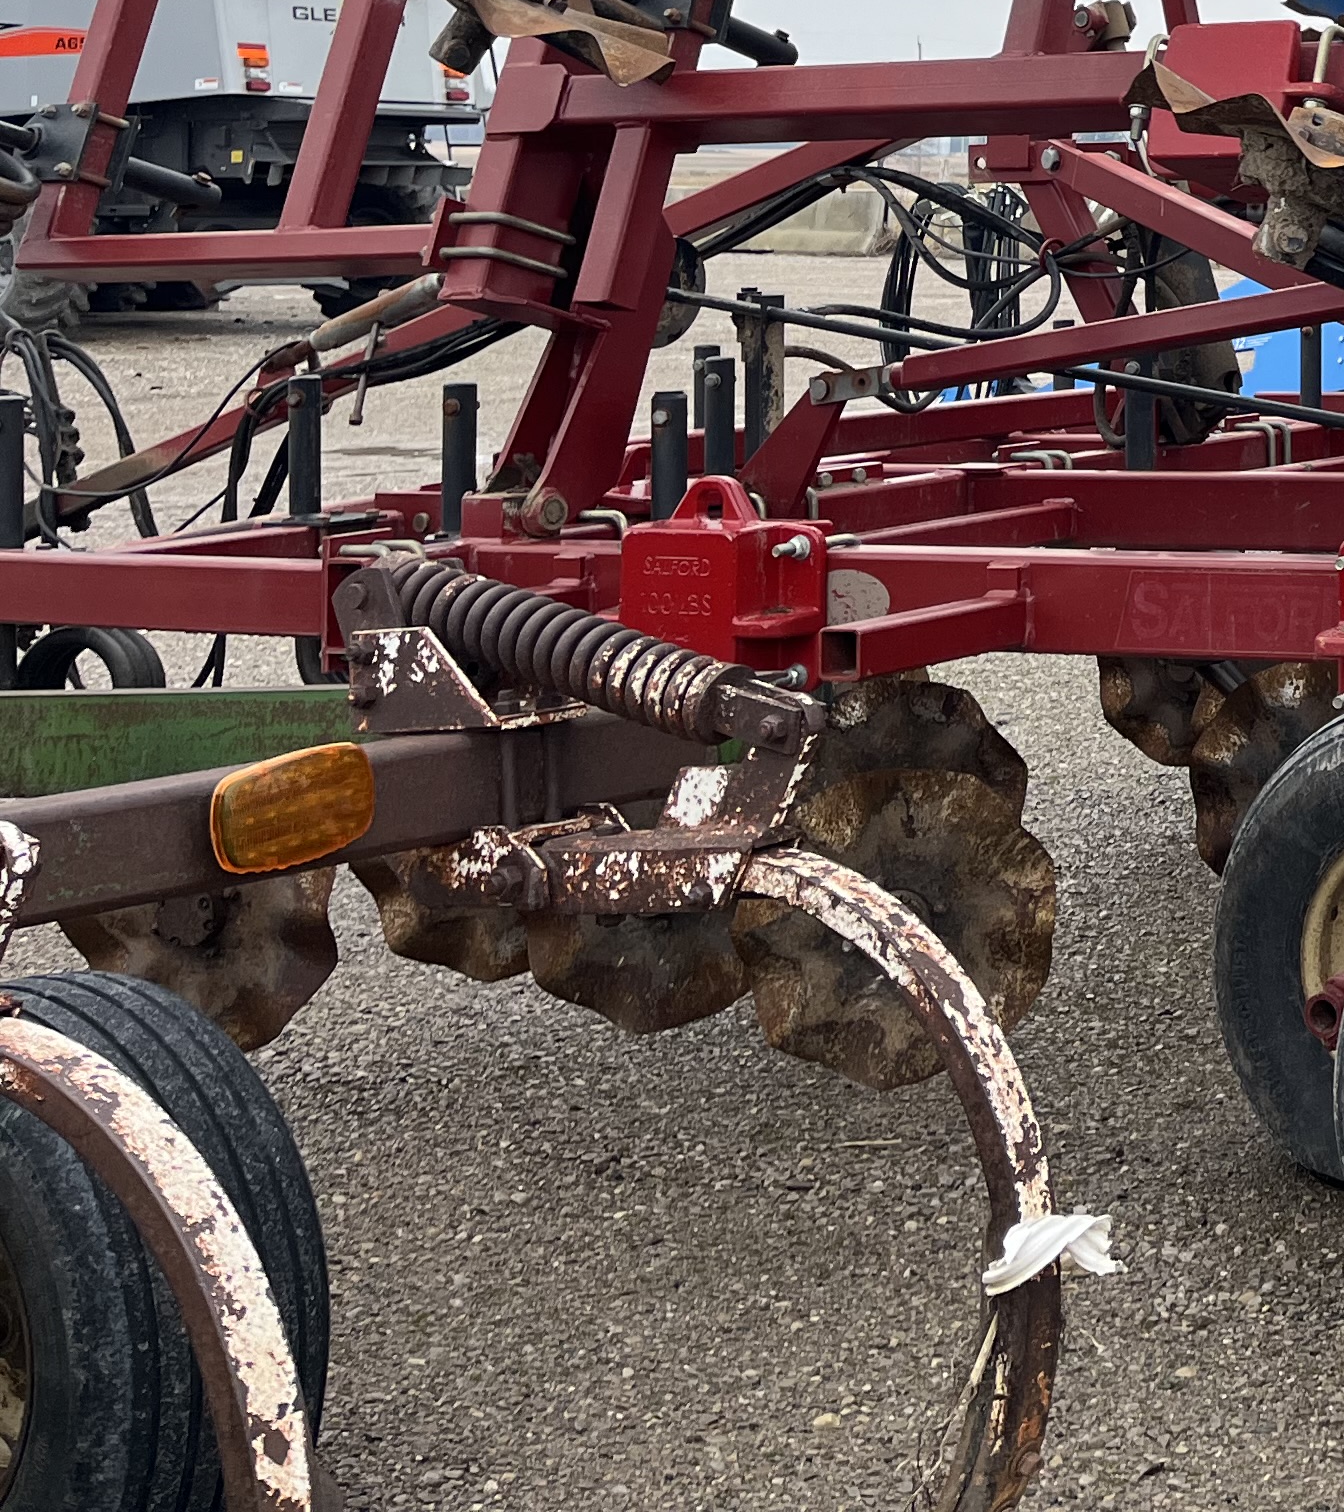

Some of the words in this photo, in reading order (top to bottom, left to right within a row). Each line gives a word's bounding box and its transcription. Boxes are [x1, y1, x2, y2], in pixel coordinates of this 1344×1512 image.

[292, 5, 337, 23] GLE
[642, 555, 712, 578] SALFORD
[1131, 580, 1328, 642] SALFOR
